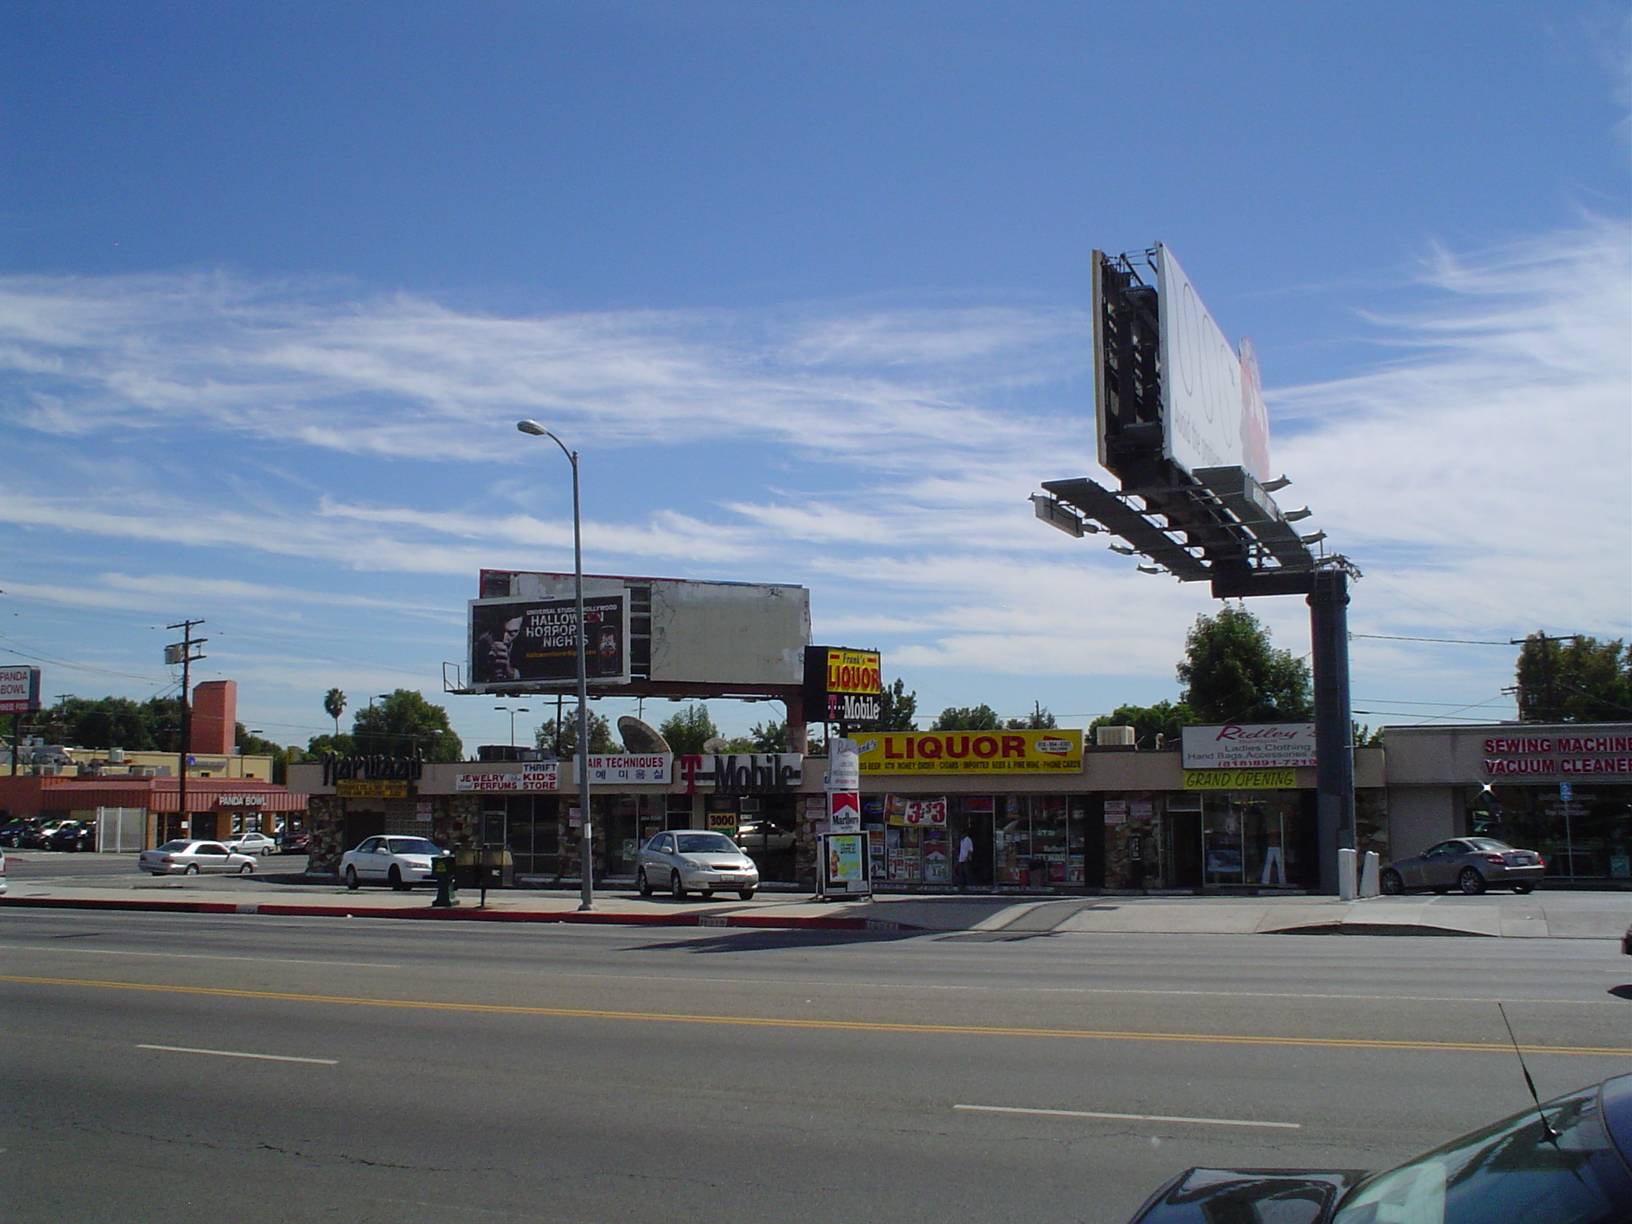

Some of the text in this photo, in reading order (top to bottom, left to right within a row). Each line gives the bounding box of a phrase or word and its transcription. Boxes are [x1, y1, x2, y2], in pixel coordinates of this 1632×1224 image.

[842, 652, 866, 665] Frank's
[0, 671, 28, 681] PANDA
[828, 664, 880, 691] LIQUOR
[0, 684, 26, 695] BOWL
[884, 735, 1026, 760] LIQUOR
[1264, 743, 1311, 753] Clothing
[1484, 738, 1552, 753] SEWING
[587, 757, 664, 768] AIR TECHNIQUES
[963, 761, 990, 769] IMPORTED
[1484, 759, 1556, 773] VACUUM
[460, 774, 505, 783] JEWELRY
[523, 773, 556, 781] KID'S
[1186, 771, 1294, 787] GRAND OPENING
[473, 782, 518, 790] PERFUMS
[522, 781, 556, 789] STORE
[219, 796, 267, 806] PANDA BOWL
[907, 802, 922, 823] 3
[710, 815, 735, 826] 3000
[832, 812, 859, 825] Marlboro
